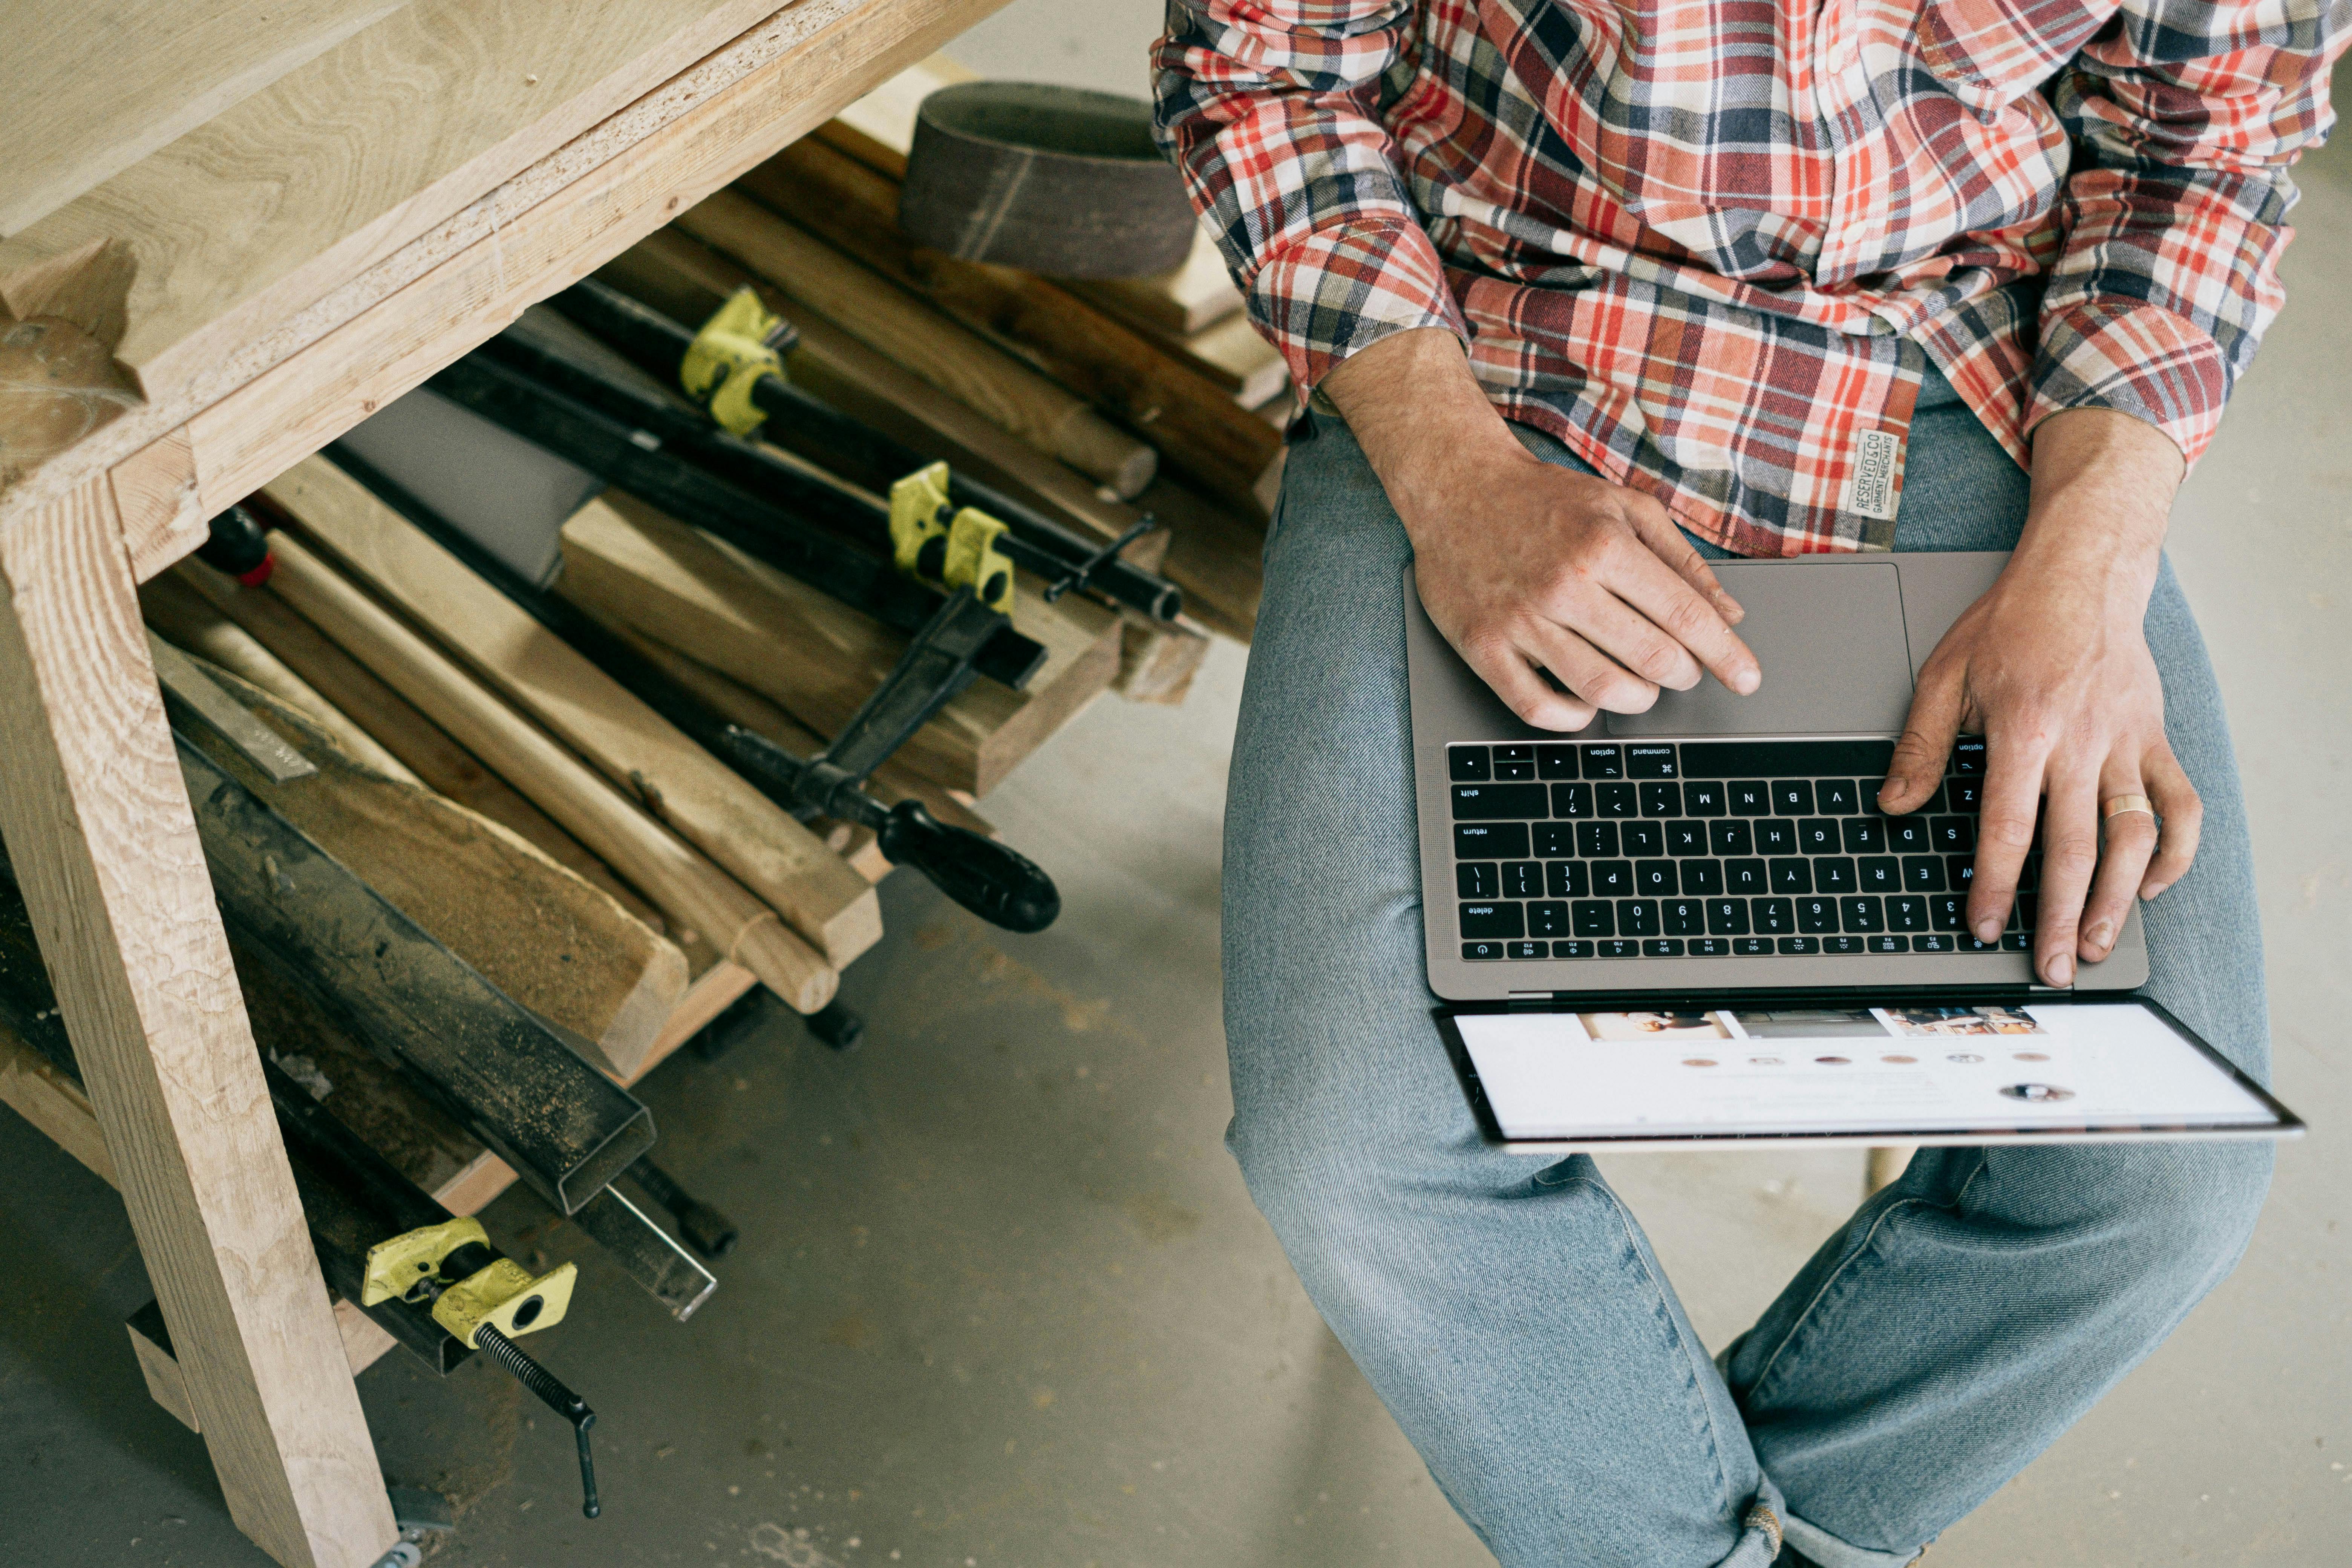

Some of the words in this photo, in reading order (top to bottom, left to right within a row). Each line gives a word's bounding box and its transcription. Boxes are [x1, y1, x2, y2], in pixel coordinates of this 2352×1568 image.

[1877, 435, 1893, 479] MERCHANTS
[1856, 459, 1877, 510] RESERVED
[1873, 479, 1885, 513] GARMENT
[1700, 795, 1710, 803] M
[1745, 794, 1753, 802] N
[1789, 793, 1797, 802] B
[1833, 792, 1841, 801] V
[1965, 791, 1972, 799] Z
[1639, 834, 1646, 843] L
[1683, 833, 1691, 842] K
[1728, 833, 1733, 842] J
[1771, 832, 1779, 841] H
[1815, 831, 1824, 841] G
[1861, 831, 1867, 840] F
[1904, 830, 1912, 839] D
[1948, 830, 1955, 838] S
[1609, 873, 1616, 882] P
[1653, 873, 1661, 882] O
[1700, 873, 1703, 882] I
[1743, 871, 1751, 881] U
[1788, 871, 1795, 880] Y
[1831, 870, 1839, 879] T
[1876, 870, 1884, 879] R
[1920, 869, 1928, 878] E
[1634, 906, 1641, 916] 0
[1679, 906, 1686, 915] 9
[1723, 905, 1731, 914] 8
[1769, 905, 1775, 914] 7
[1813, 904, 1821, 913] 6
[1858, 903, 1865, 913] 5
[1902, 903, 1909, 912] 4
[1947, 902, 1954, 911] 3
